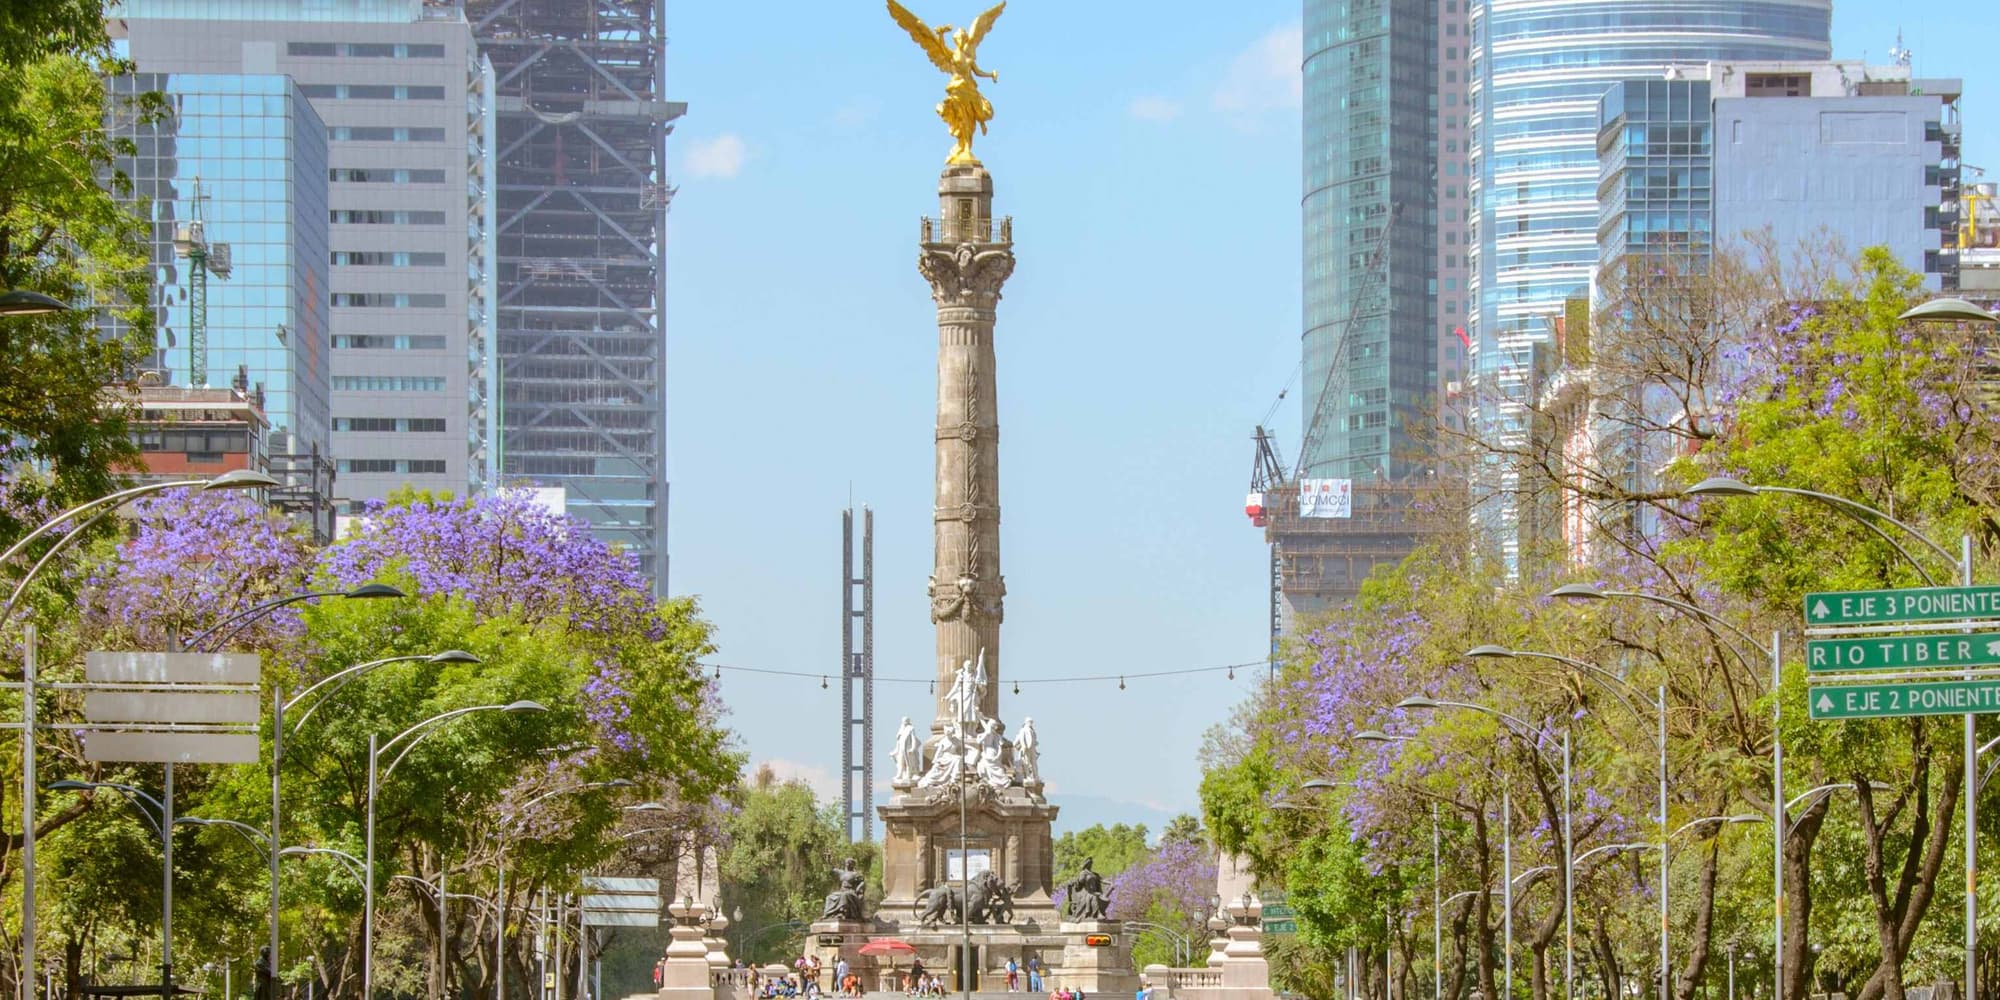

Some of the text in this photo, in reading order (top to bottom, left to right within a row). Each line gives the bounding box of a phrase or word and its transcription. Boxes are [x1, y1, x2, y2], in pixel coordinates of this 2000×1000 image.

[1841, 592, 2000, 618] EJE 3 PONIENTE
[1813, 641, 1972, 665] RIO TIBER
[1846, 691, 1881, 712] EJE
[1889, 691, 1900, 710] 2
